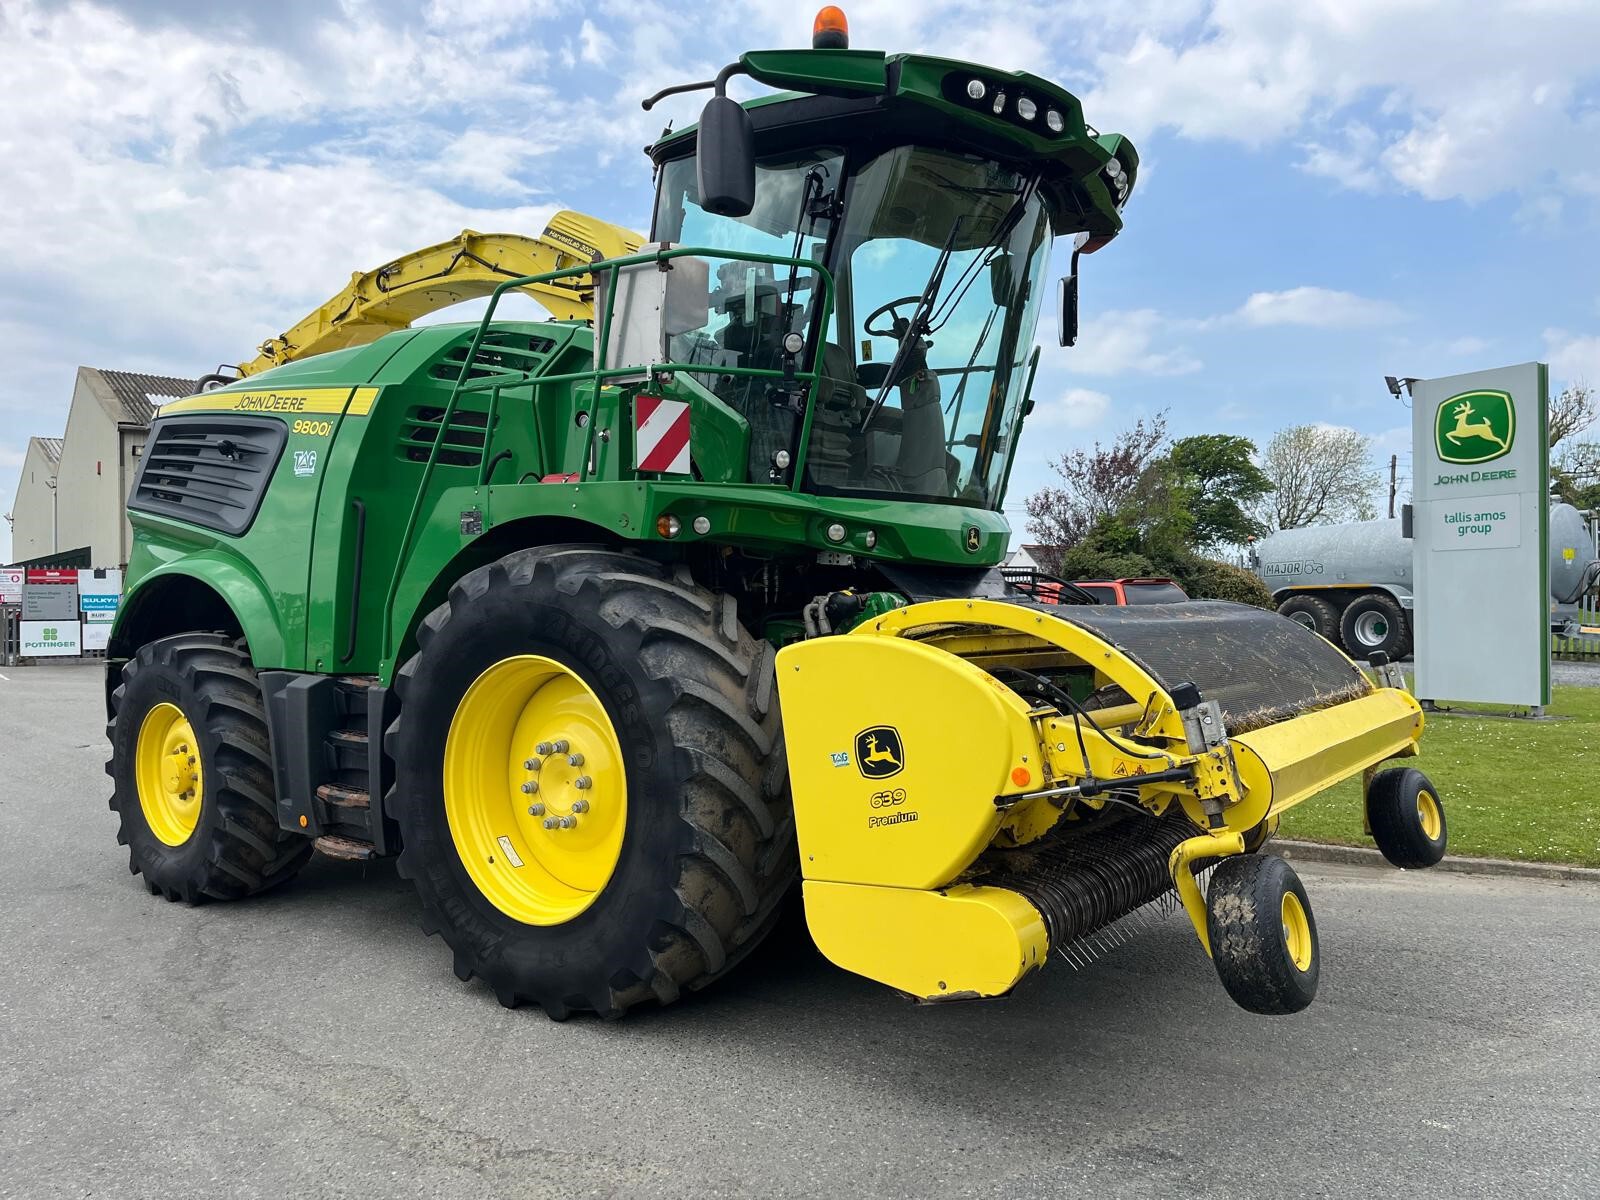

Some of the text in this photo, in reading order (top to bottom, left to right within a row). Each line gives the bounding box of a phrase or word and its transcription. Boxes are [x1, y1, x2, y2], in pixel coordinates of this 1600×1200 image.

[548, 230, 596, 256] HarvestLab 3000
[234, 394, 307, 410] JOHN DEERE
[292, 419, 334, 437] 9800i
[294, 450, 317, 469] TAG
[1434, 470, 1516, 485] JOHN DEERE
[1444, 511, 1506, 523] tallis amos
[1458, 523, 1492, 536] group
[1267, 563, 1300, 574] MAJOR
[831, 752, 848, 763] TAG
[870, 788, 906, 808] 639
[868, 812, 918, 828] Premium
